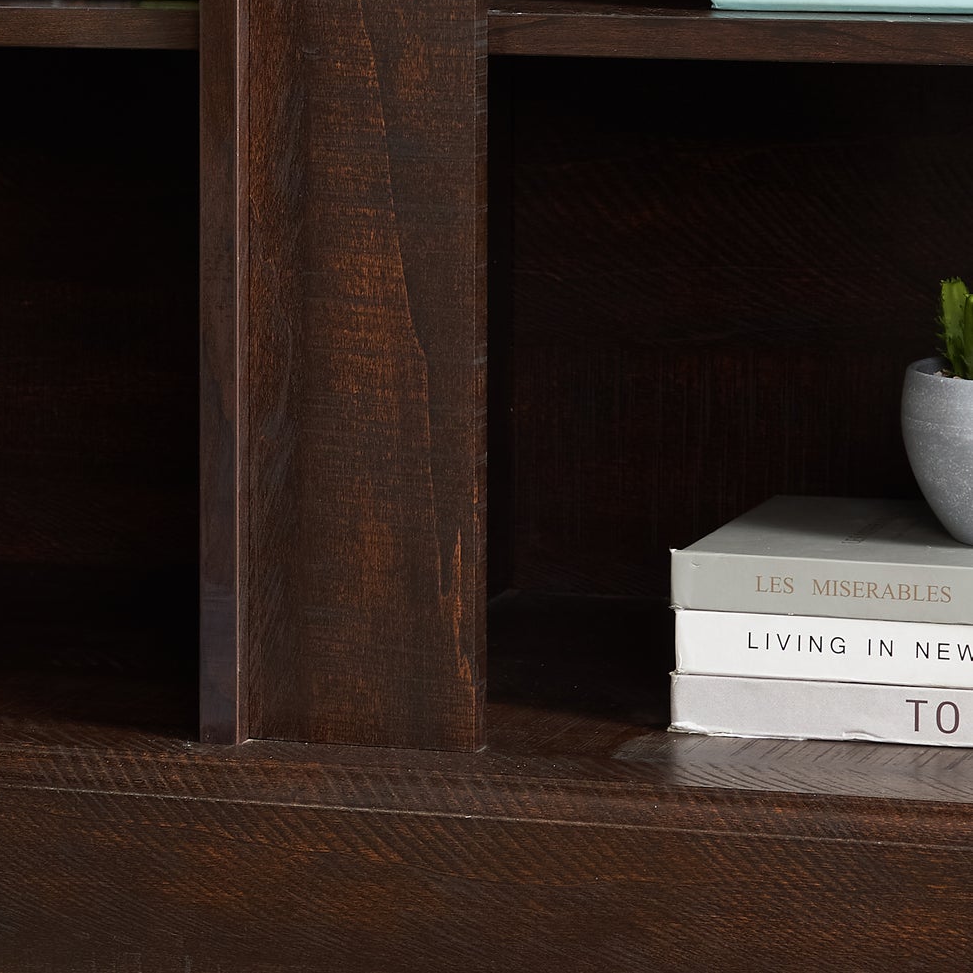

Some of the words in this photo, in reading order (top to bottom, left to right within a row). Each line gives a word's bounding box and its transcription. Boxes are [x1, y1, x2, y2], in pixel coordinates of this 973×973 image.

[755, 575, 795, 595] LES
[812, 579, 952, 603] MISERABLES
[748, 632, 846, 654] LIVING
[868, 639, 894, 657] IN
[915, 642, 973, 661] NEW
[906, 699, 960, 734] TO
